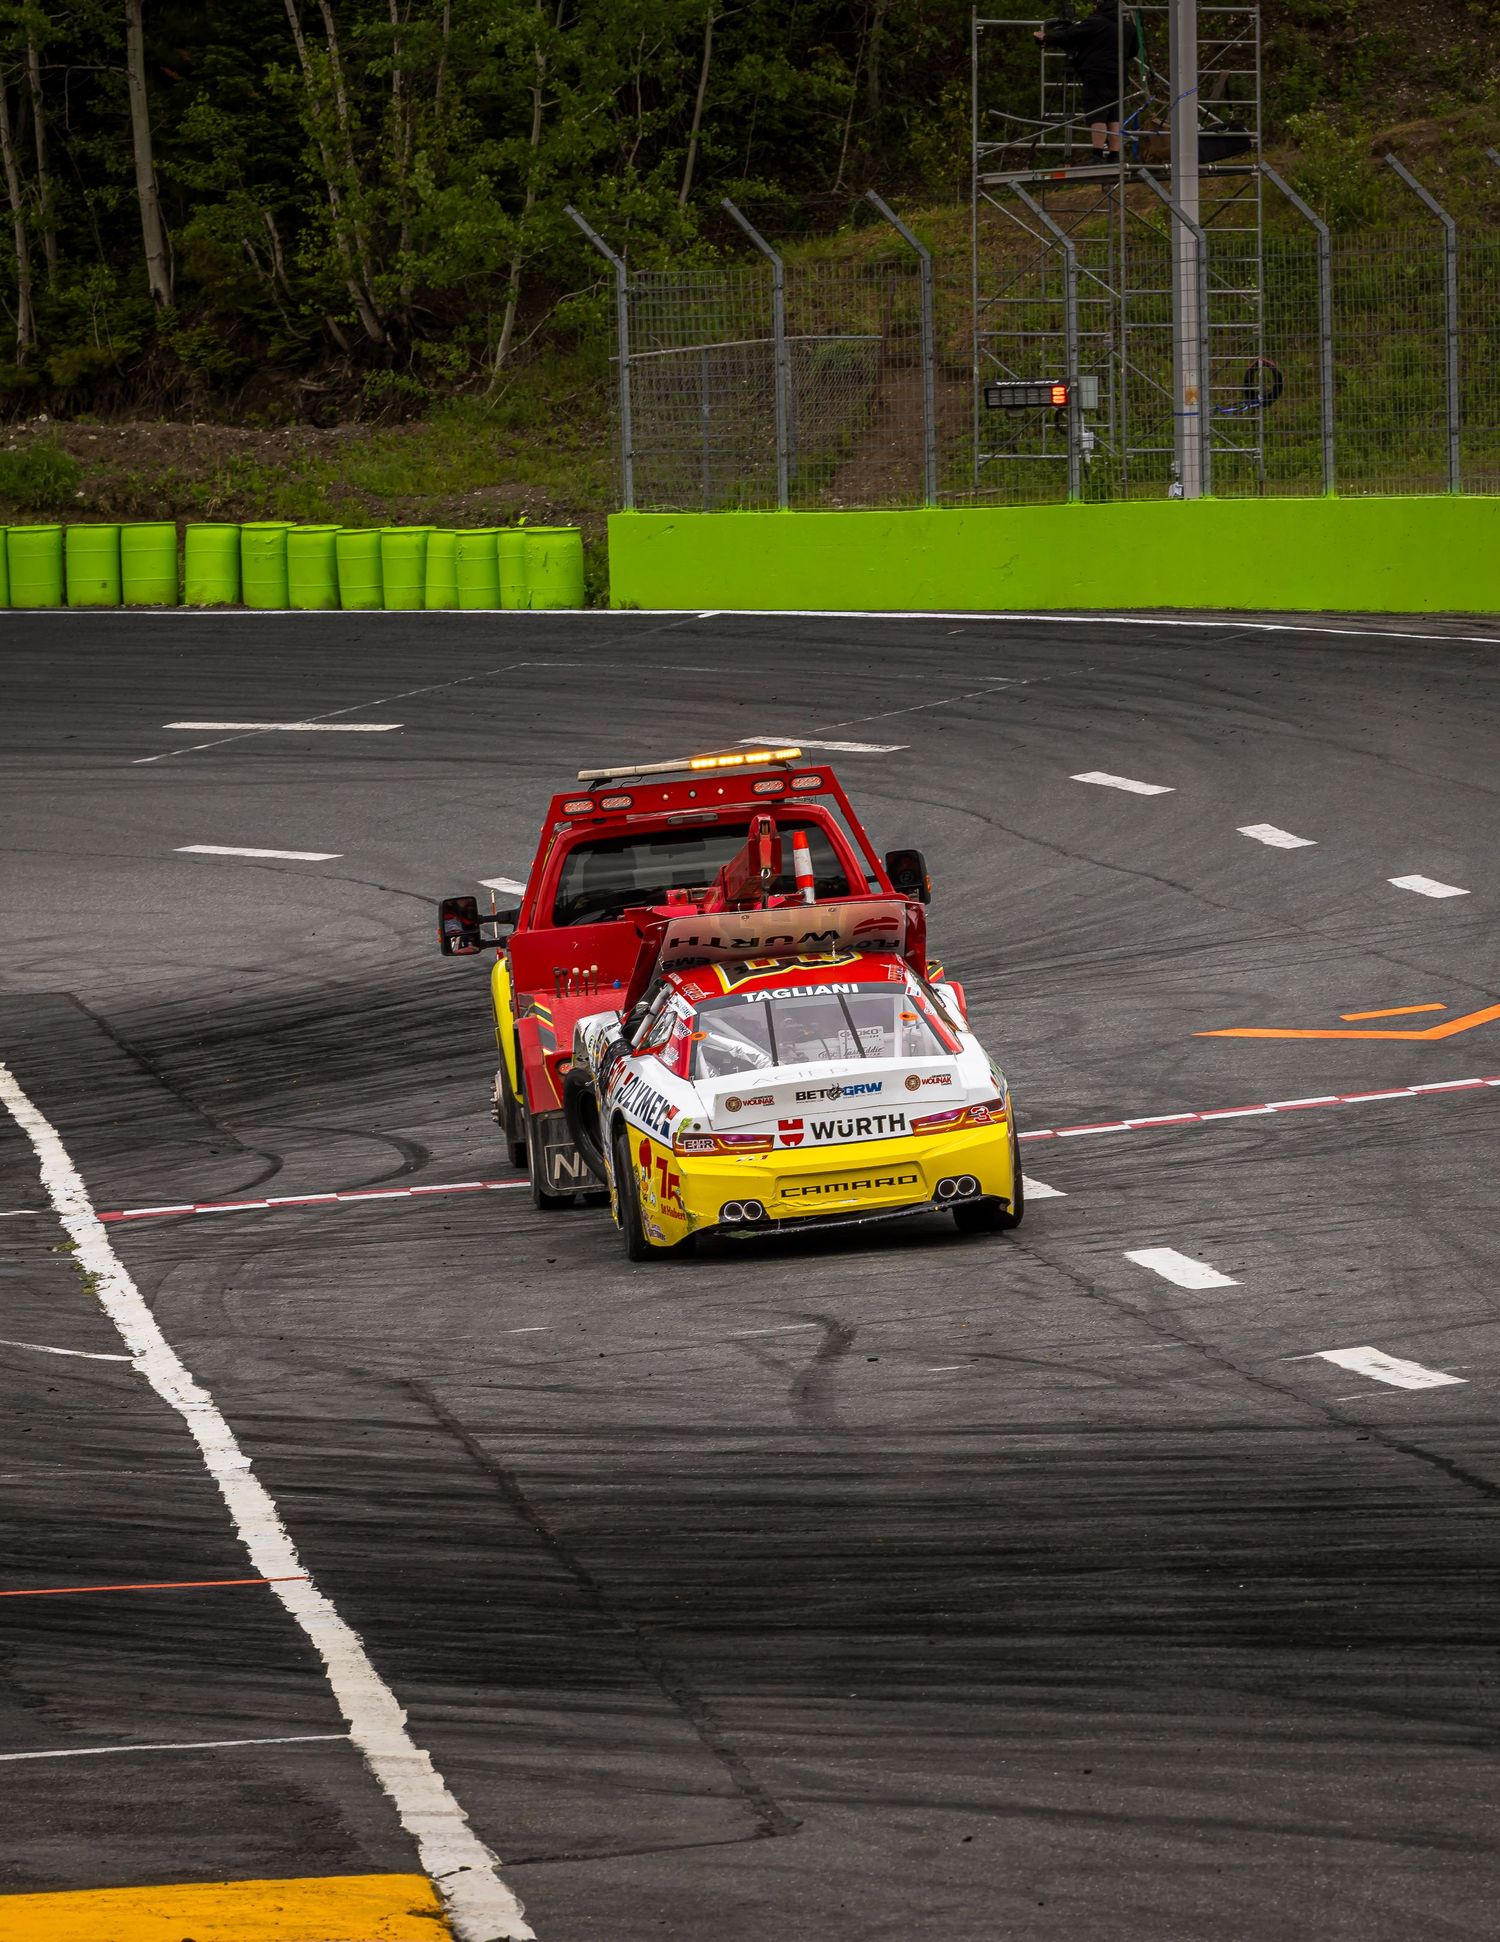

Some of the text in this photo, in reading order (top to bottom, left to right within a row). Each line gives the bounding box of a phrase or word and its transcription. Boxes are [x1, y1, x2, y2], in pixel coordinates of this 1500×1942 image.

[742, 983, 860, 1003] TAGLIANI
[795, 1089, 828, 1102] BET
[843, 1081, 883, 1096] GRW
[971, 1105, 998, 1123] 3
[810, 1112, 906, 1140] WÜRTH
[780, 1174, 918, 1198] CAMARO
